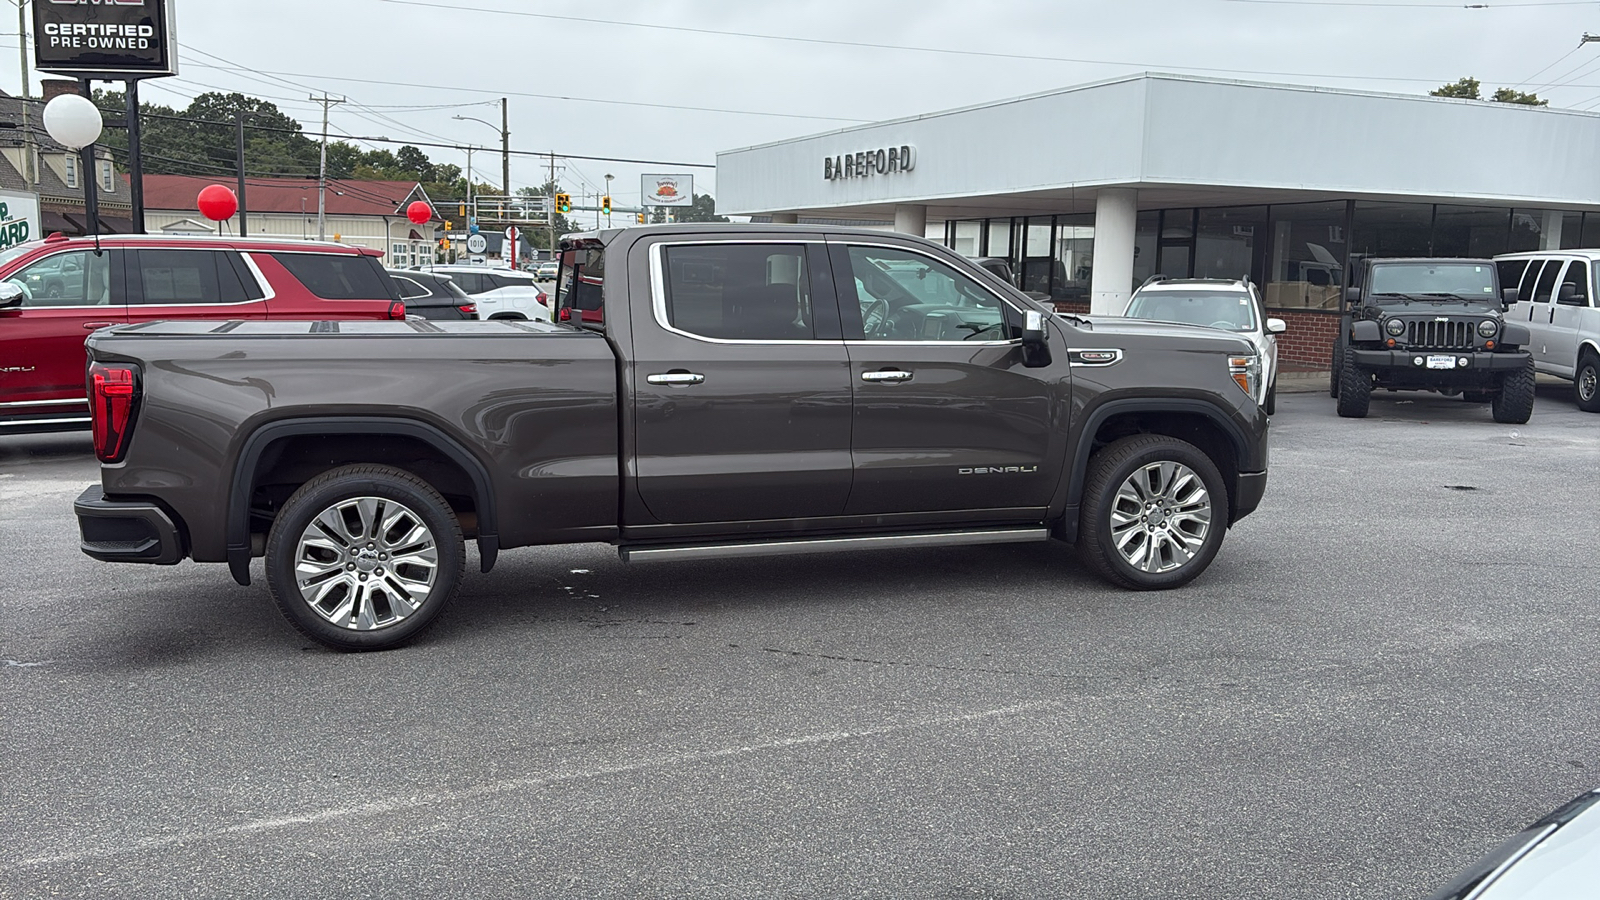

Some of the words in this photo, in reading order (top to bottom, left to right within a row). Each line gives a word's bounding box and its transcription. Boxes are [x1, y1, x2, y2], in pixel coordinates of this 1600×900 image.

[44, 23, 153, 37] CERTIFIED
[50, 36, 149, 49] PRE-OWNED
[824, 144, 916, 181] BAREFORD
[470, 239, 484, 248] 1010
[958, 465, 1038, 475] DENALI
